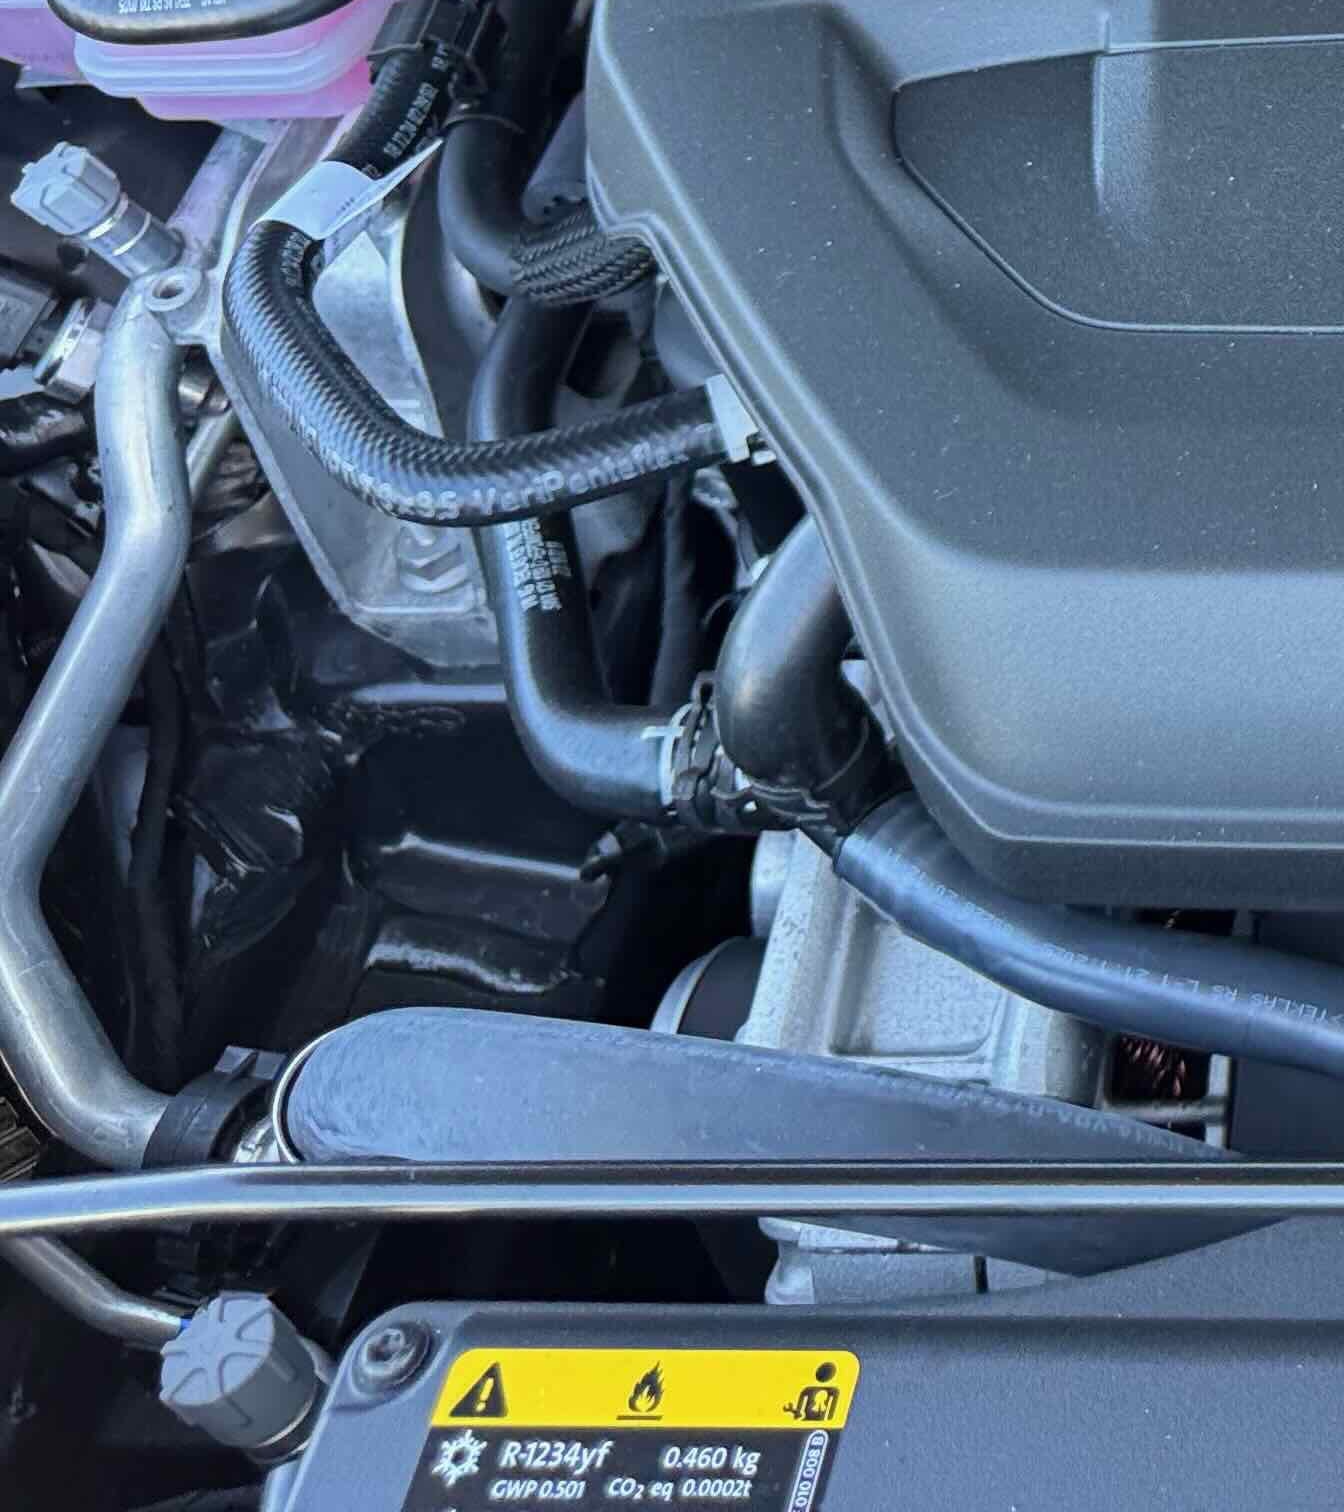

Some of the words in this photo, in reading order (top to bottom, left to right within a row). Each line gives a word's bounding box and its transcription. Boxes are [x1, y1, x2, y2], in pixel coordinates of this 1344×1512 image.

[500, 1440, 614, 1475] R-1234yf
[662, 1446, 728, 1469] 0.460
[732, 1445, 761, 1476] kg
[490, 1479, 538, 1499] GWP
[538, 1479, 586, 1499] 0.501
[650, 1483, 674, 1502] eq
